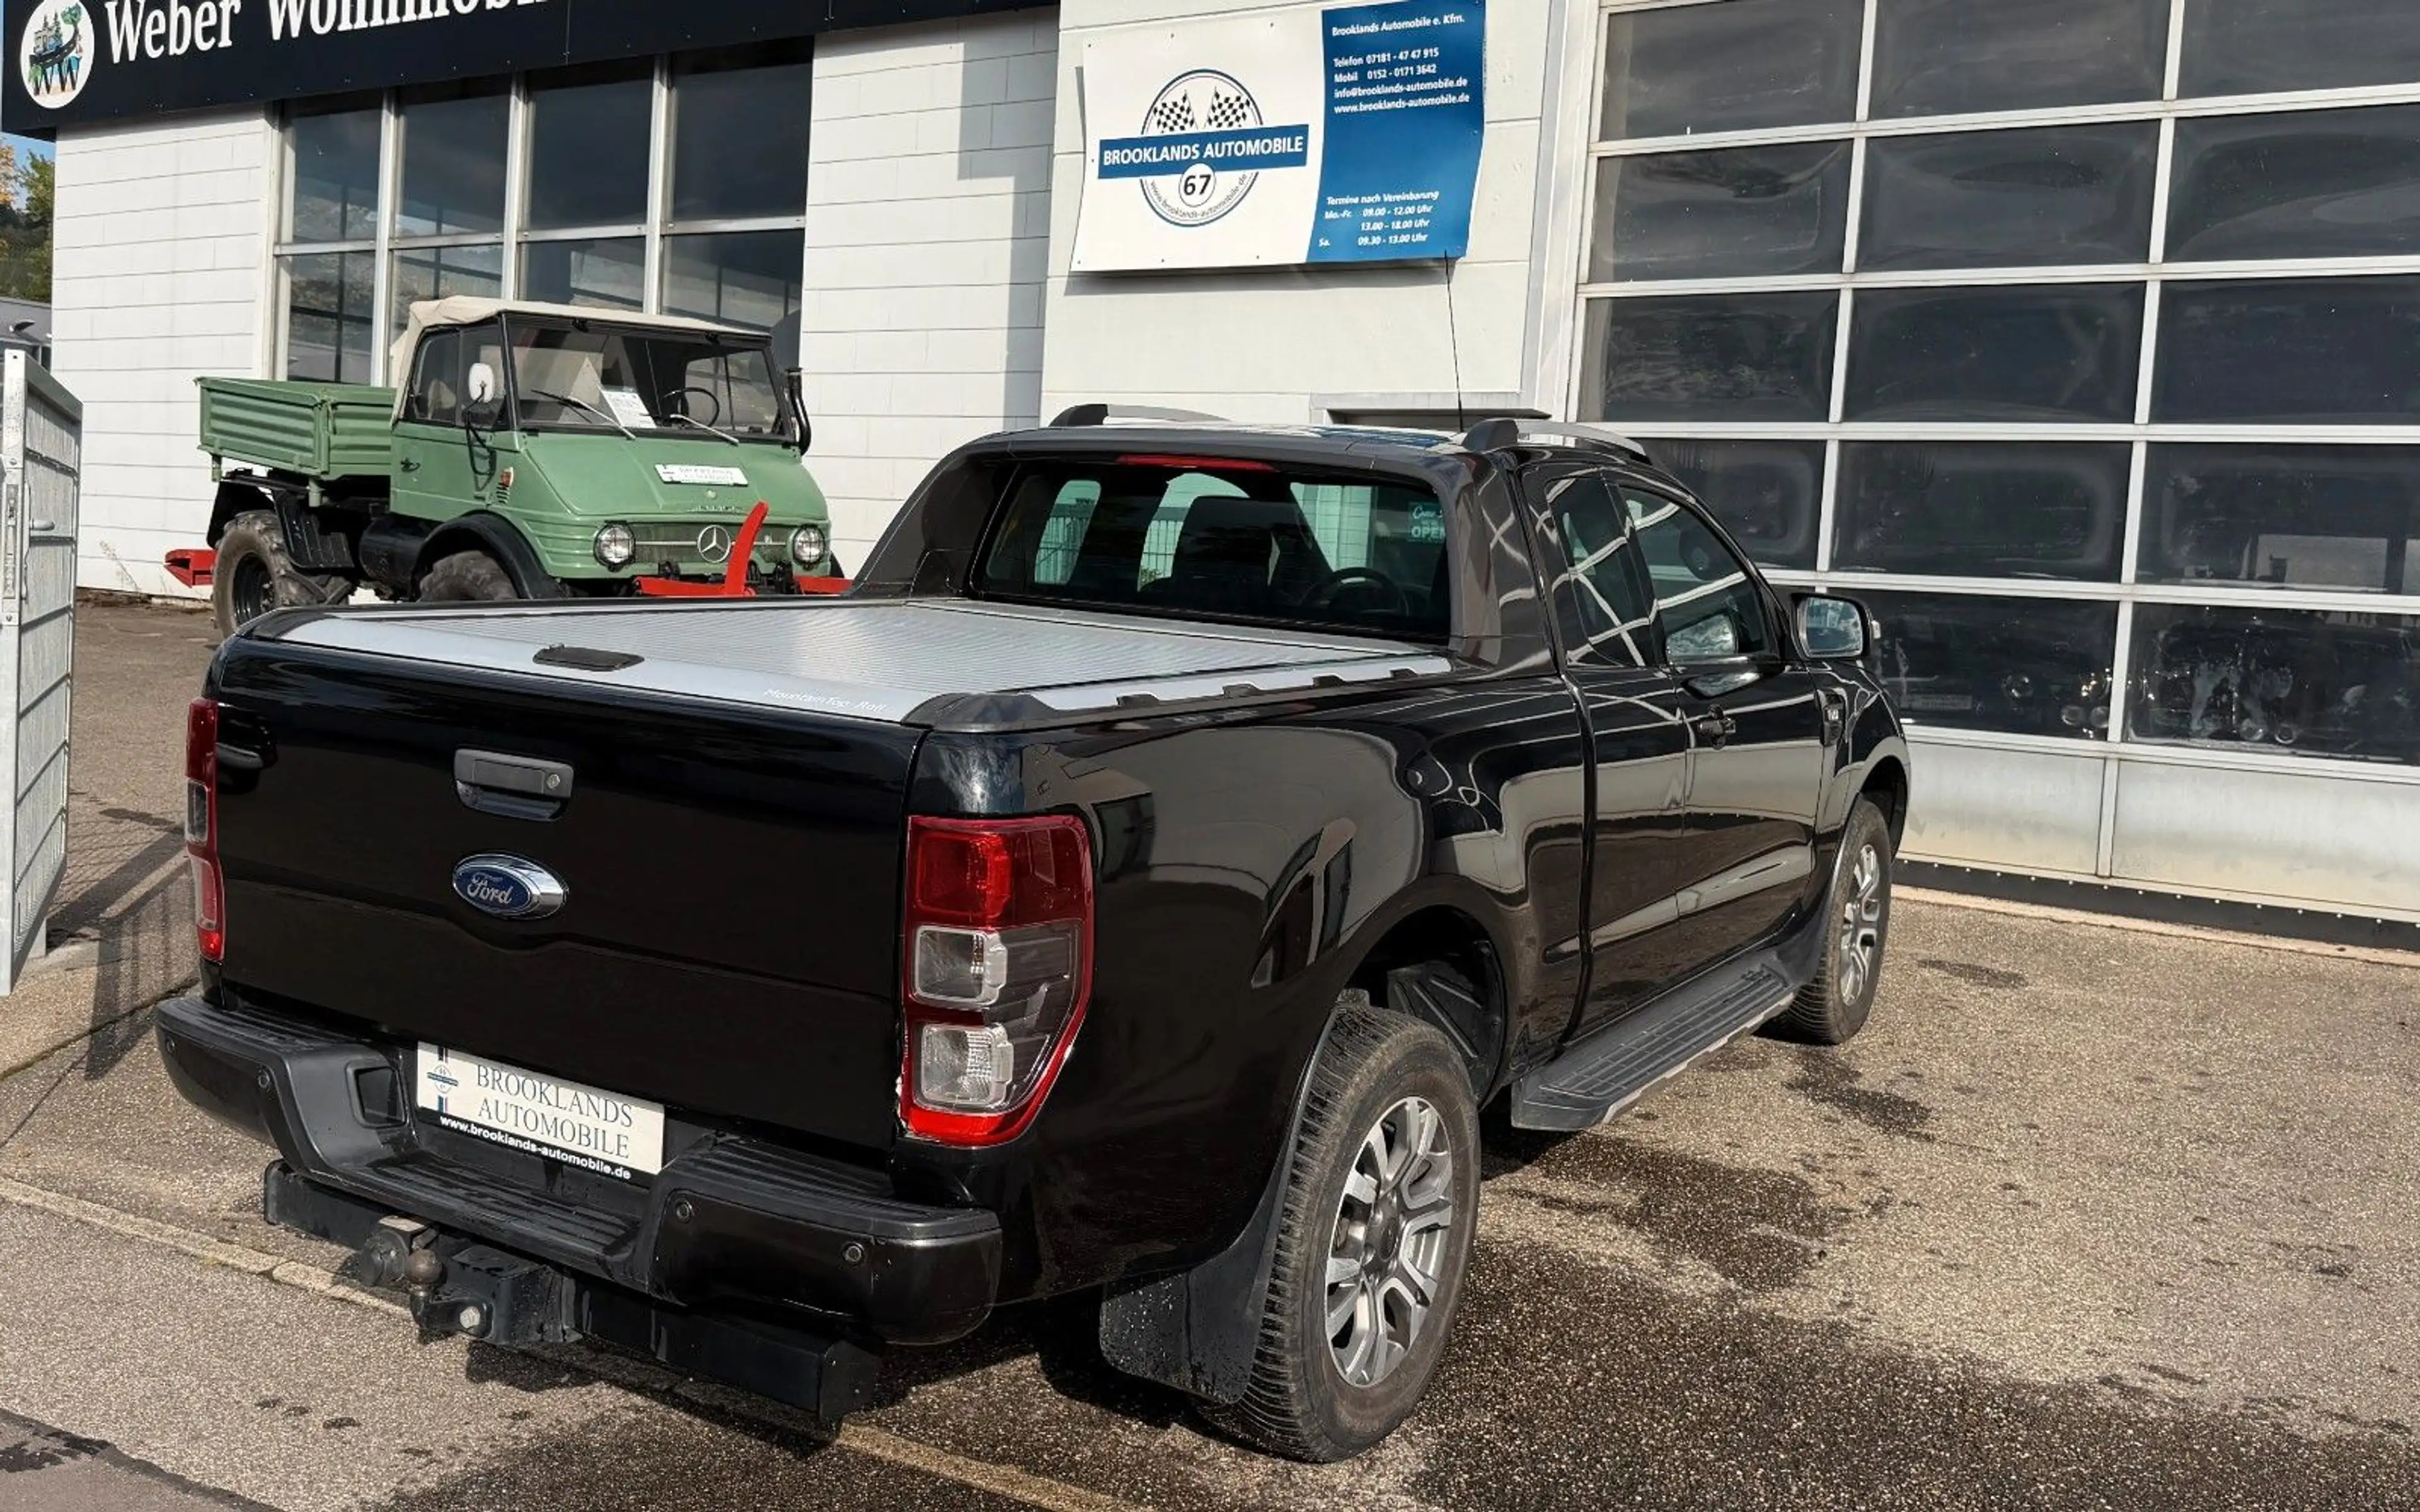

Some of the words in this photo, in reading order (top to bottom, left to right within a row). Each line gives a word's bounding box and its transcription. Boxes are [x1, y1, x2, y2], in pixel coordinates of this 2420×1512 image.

[105, 0, 241, 64] Weber
[1332, 23, 1379, 37] Brooklands
[1381, 16, 1431, 32] Automobile
[1443, 14, 1465, 24] Kfm.
[1333, 57, 1363, 67] Telefon
[1366, 52, 1391, 64] 07181
[1423, 47, 1439, 58] 915
[1334, 72, 1358, 83] Mobil
[1367, 68, 1386, 79] 0152
[1395, 66, 1414, 77] 0171
[1334, 76, 1468, 98] info@brooklands-automobile.de
[1334, 93, 1470, 114] www.brooklands-automobile.de
[1103, 144, 1199, 166] BROOKLANDS
[1202, 135, 1304, 159] AUTOMOBILE
[1184, 174, 1211, 196] 67
[1327, 195, 1359, 205] Termine
[1361, 193, 1381, 203] nach
[1383, 190, 1439, 202] Vereinbarung
[1417, 204, 1434, 213] Uhr
[1414, 219, 1431, 228] Uhr
[1411, 232, 1429, 242] Uhr
[467, 872, 514, 905] Ford
[477, 1064, 633, 1127] BROOKLANDS
[478, 1097, 630, 1159] AUTOMOBILE
[440, 1116, 631, 1180] www.brooklands-automobile.de
